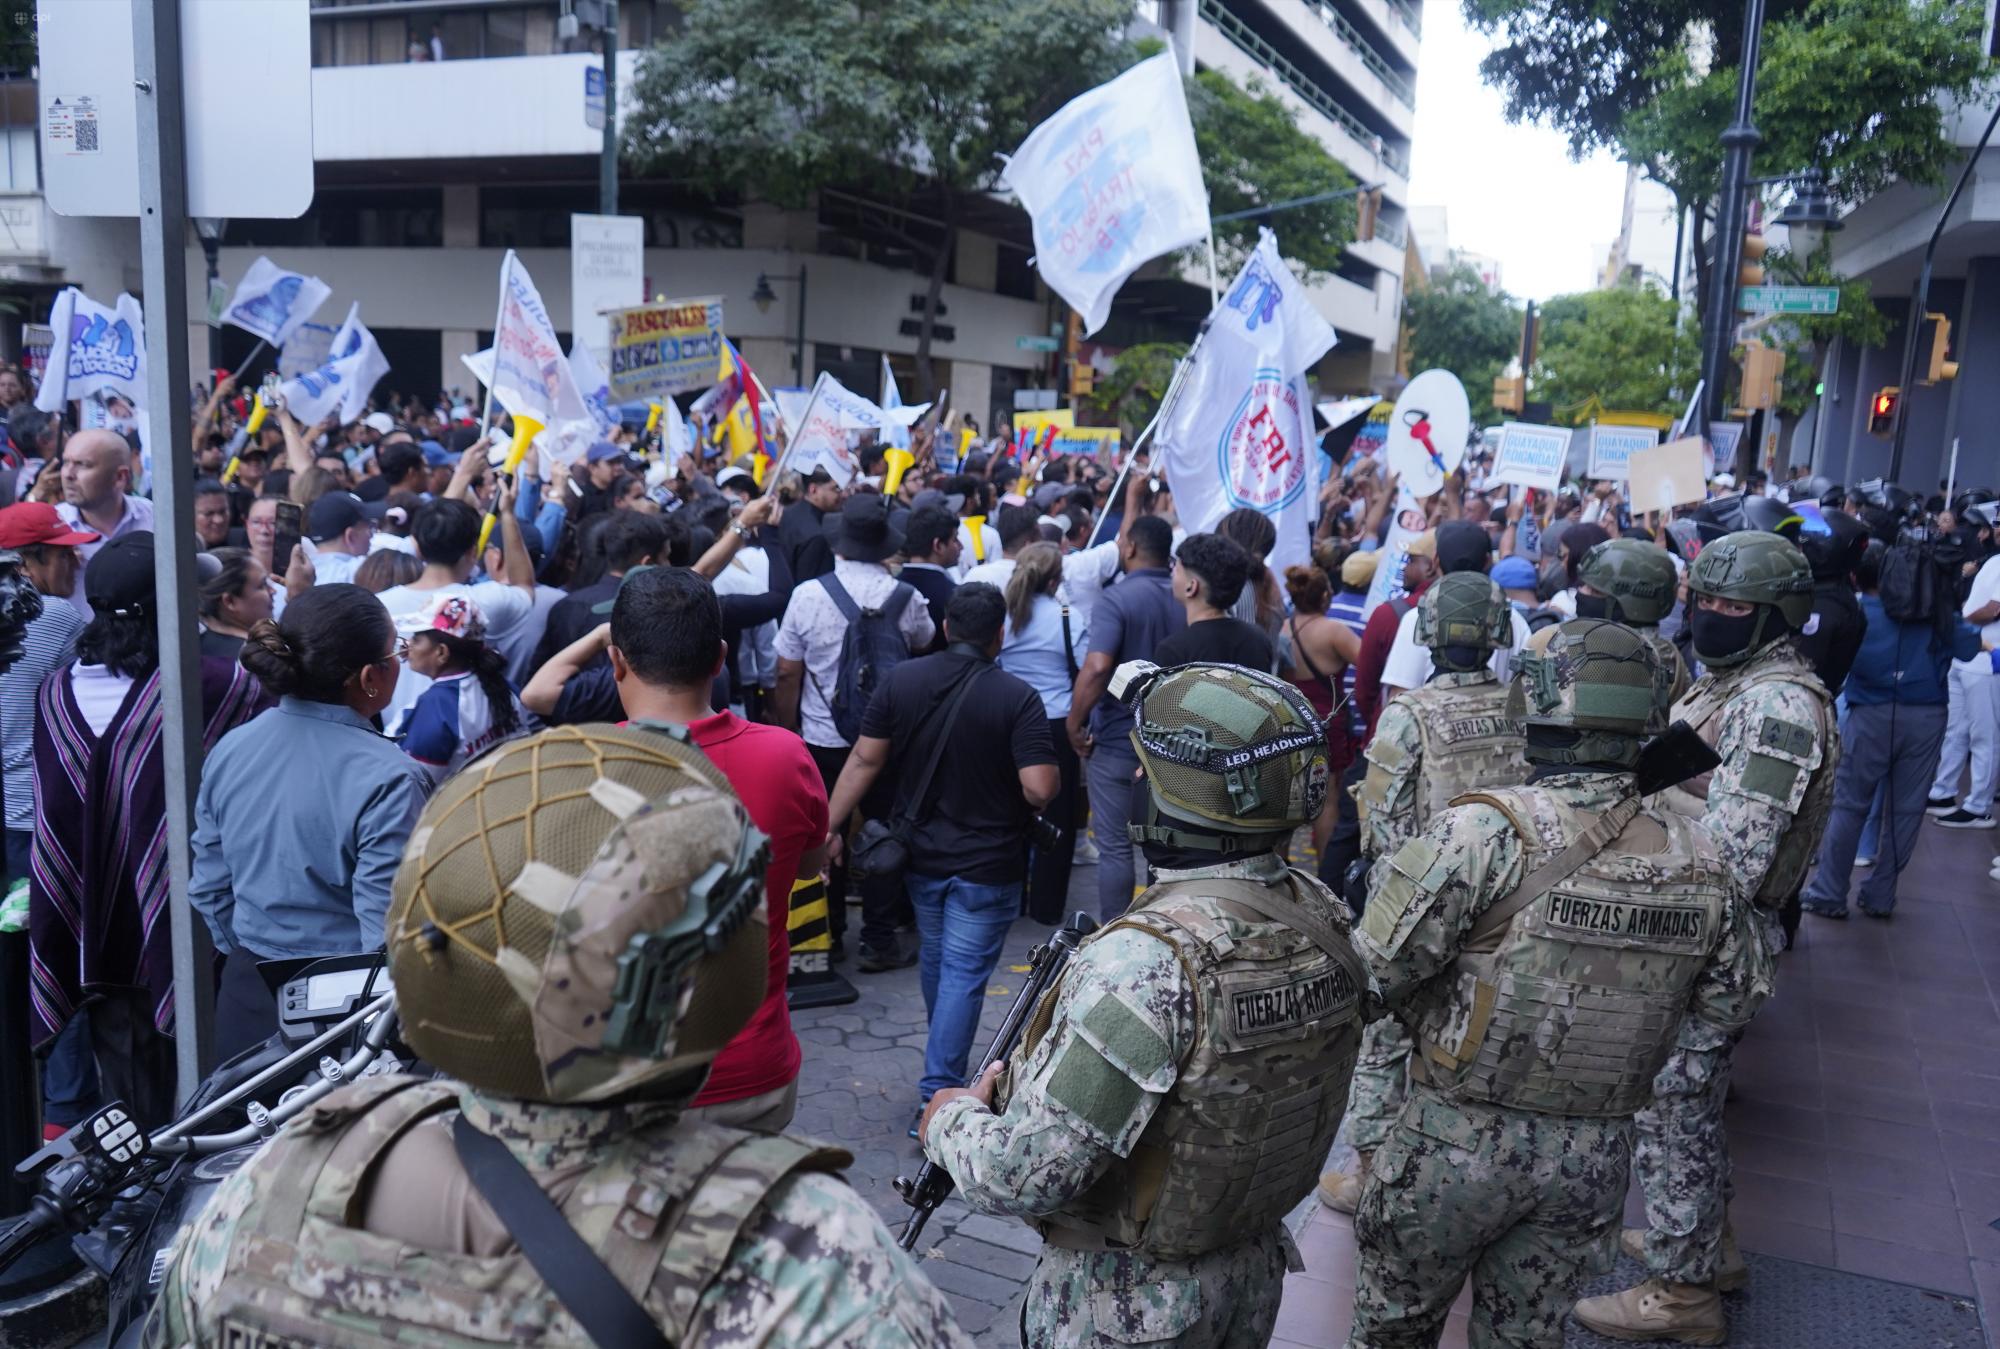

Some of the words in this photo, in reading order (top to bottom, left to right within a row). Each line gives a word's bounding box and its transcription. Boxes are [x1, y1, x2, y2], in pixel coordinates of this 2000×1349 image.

[626, 304, 706, 337] PASCUALES
[1249, 402, 1293, 475] FRI
[1506, 433, 1560, 452] GUAYAQUIL
[1226, 752, 1251, 767] LED
[1549, 897, 1624, 932] FUERZAS
[1626, 907, 1700, 938] ARMADAS
[1236, 983, 1302, 1031] FUERZAS
[1303, 964, 1356, 1016] ARMADA
[113, 1112, 120, 1121] 2
